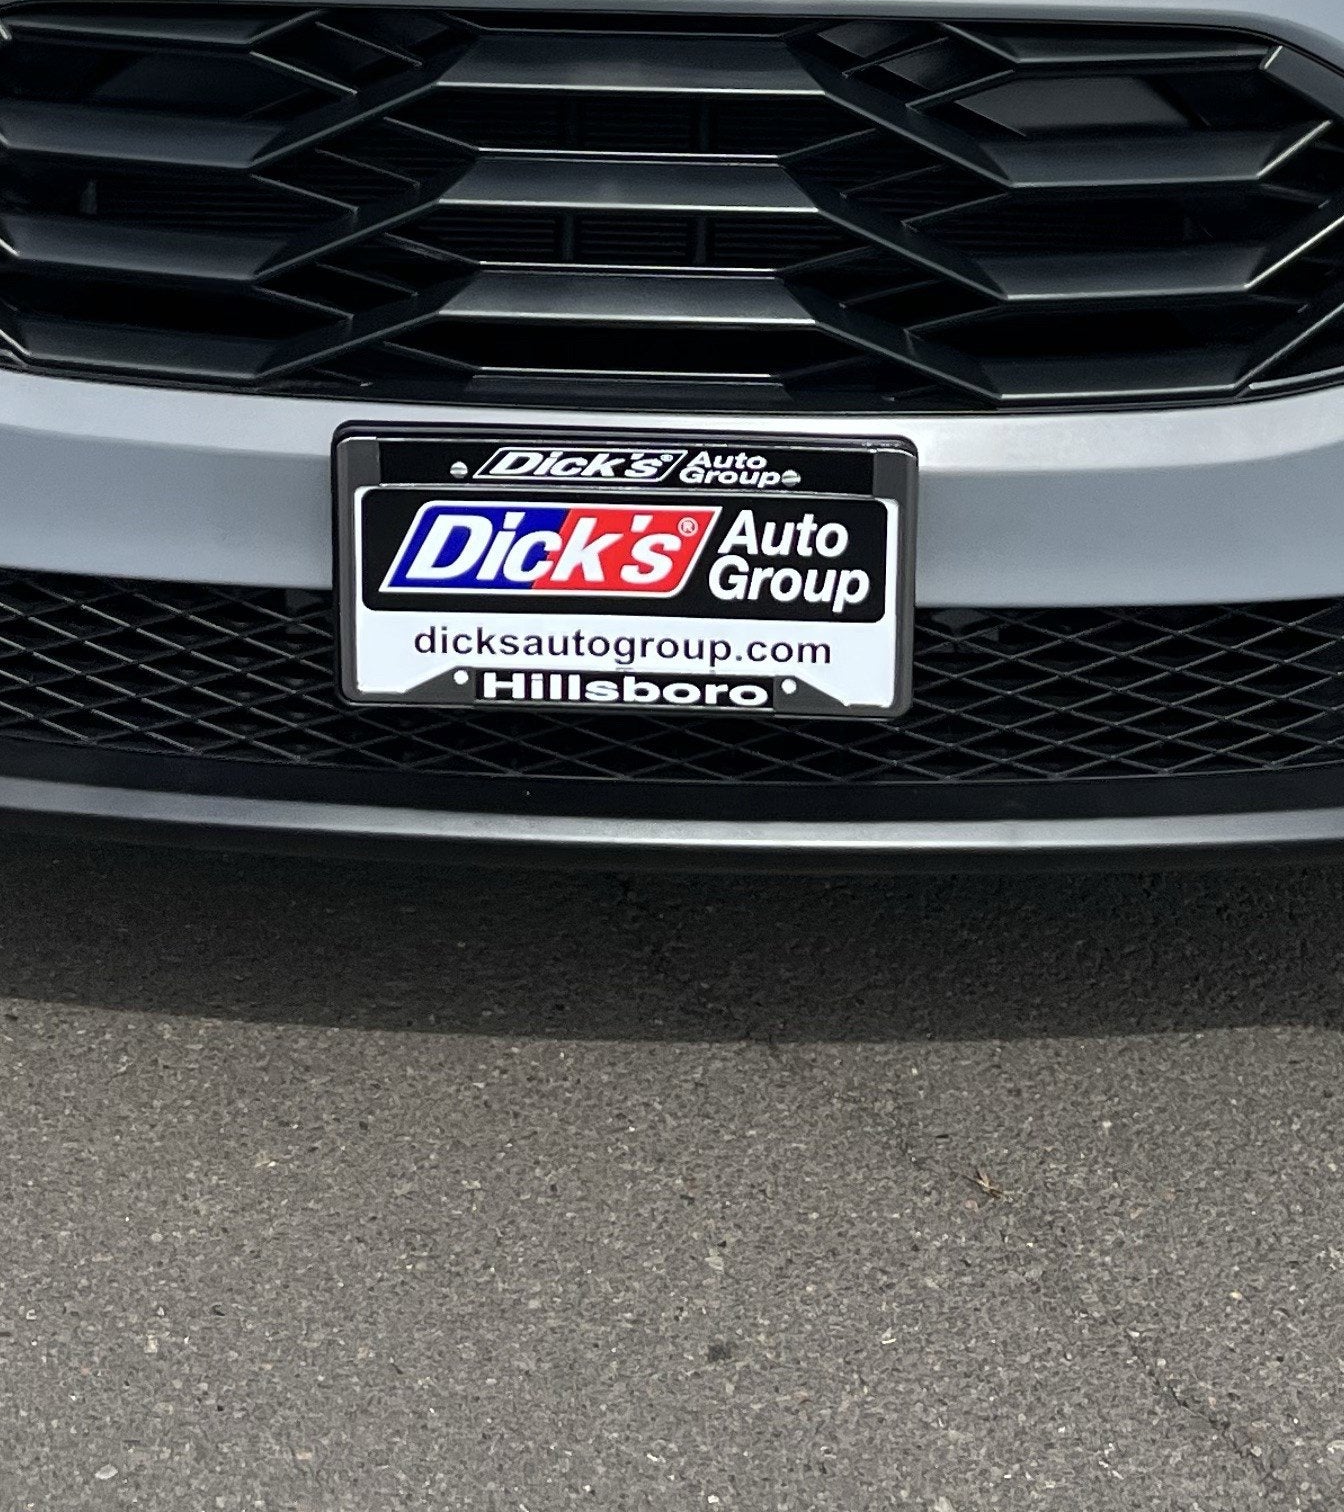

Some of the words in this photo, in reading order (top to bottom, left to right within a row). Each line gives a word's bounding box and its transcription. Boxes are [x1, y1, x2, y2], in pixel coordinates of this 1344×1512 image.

[678, 466, 782, 488] Group
[685, 450, 768, 470] Auto
[718, 509, 849, 558] Auto
[708, 554, 871, 614] Group
[413, 625, 832, 666] dicksautogroup.com
[482, 670, 769, 707] Hillsboro
